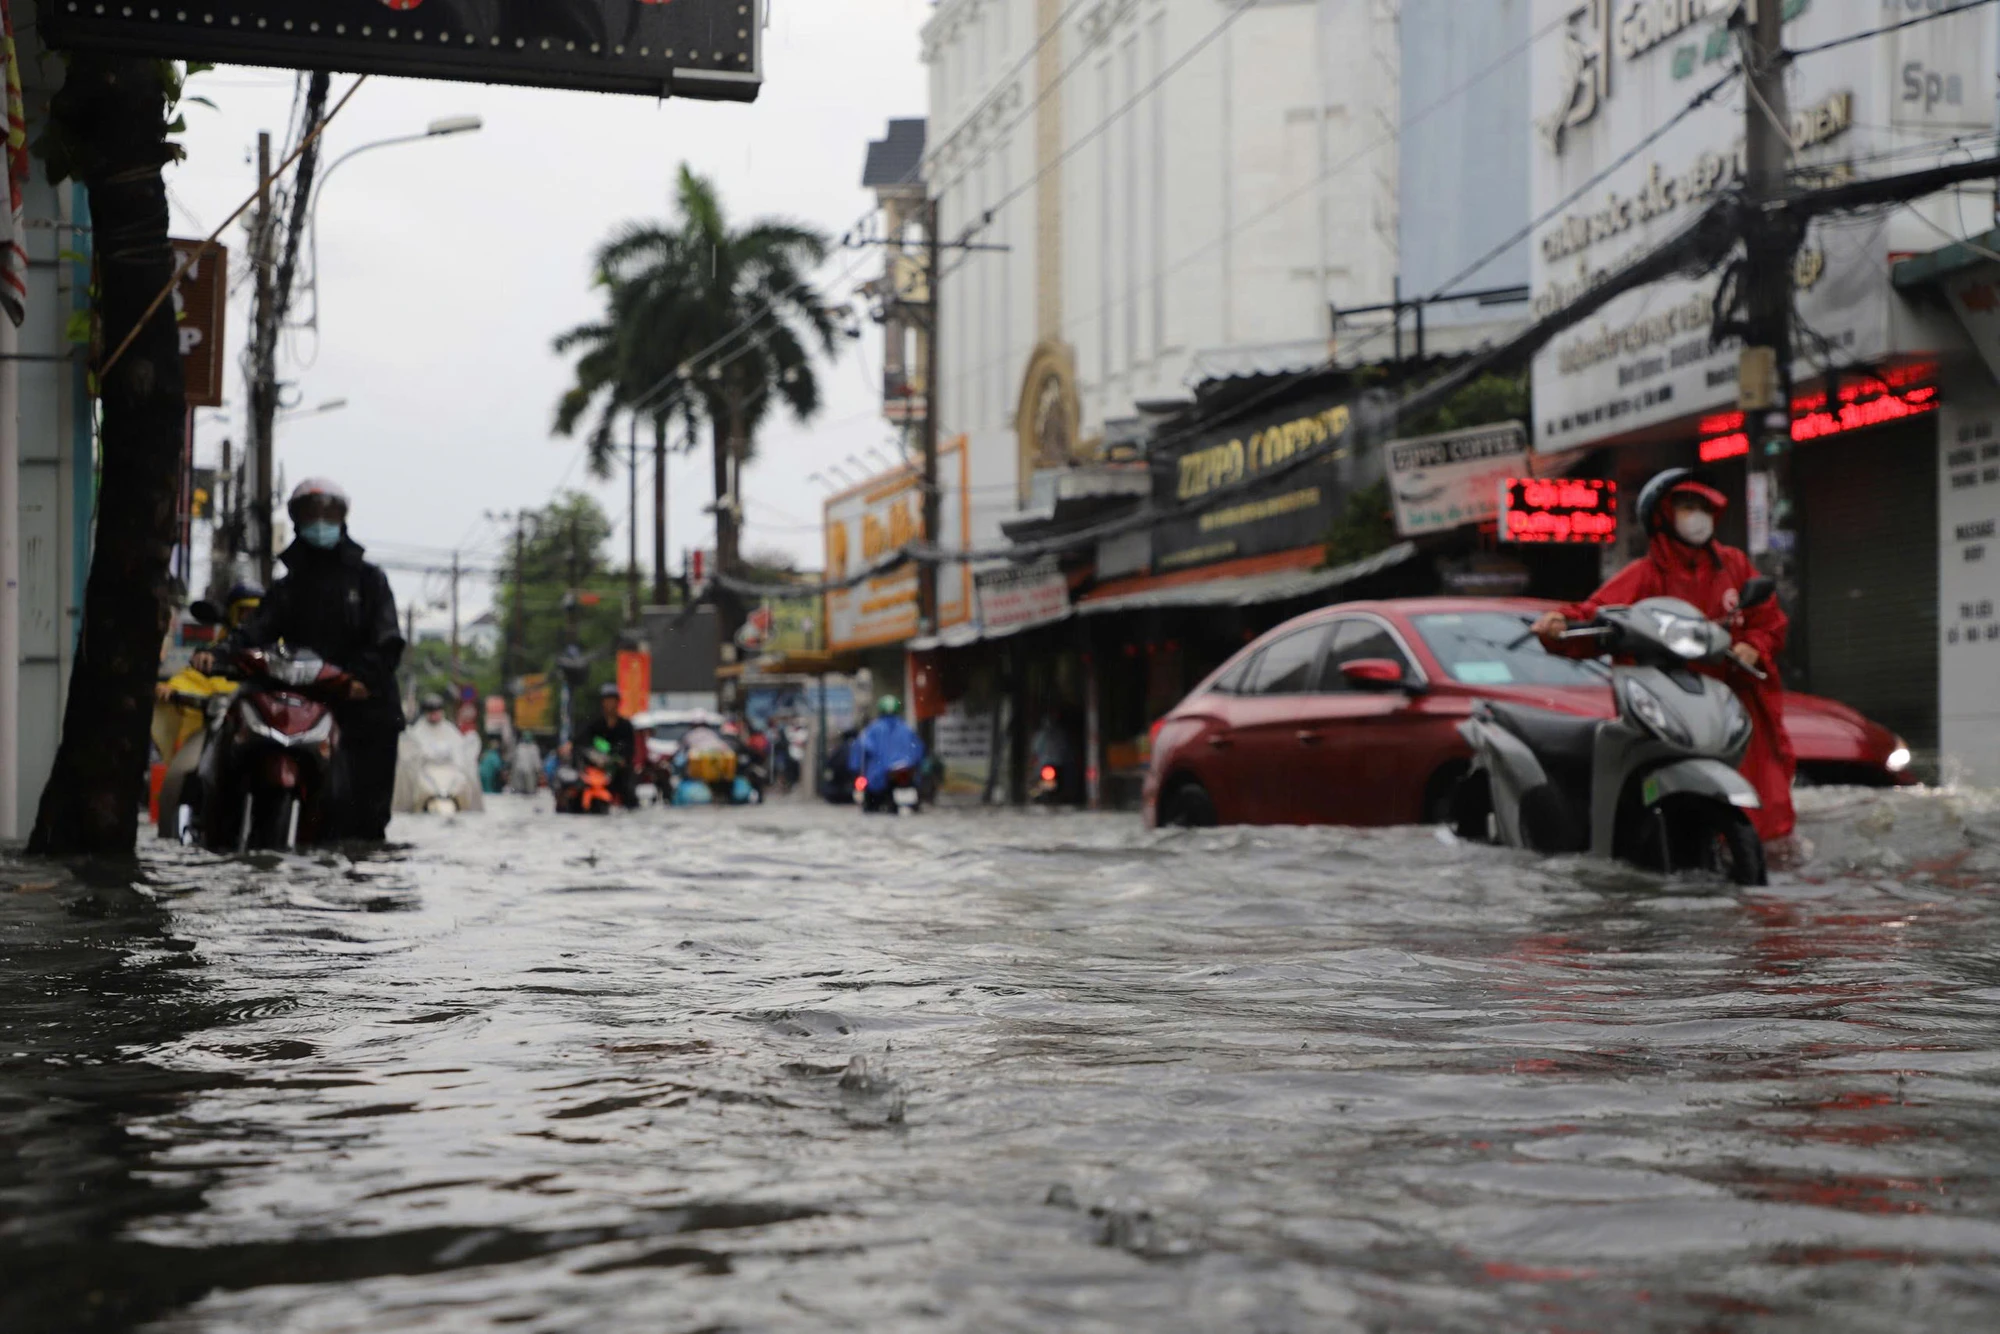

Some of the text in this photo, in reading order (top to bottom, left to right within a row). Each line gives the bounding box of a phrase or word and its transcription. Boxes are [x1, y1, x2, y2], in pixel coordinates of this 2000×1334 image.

[1902, 62, 1963, 113] Spa
[1177, 404, 1350, 499] ZIPPO COFFEE
